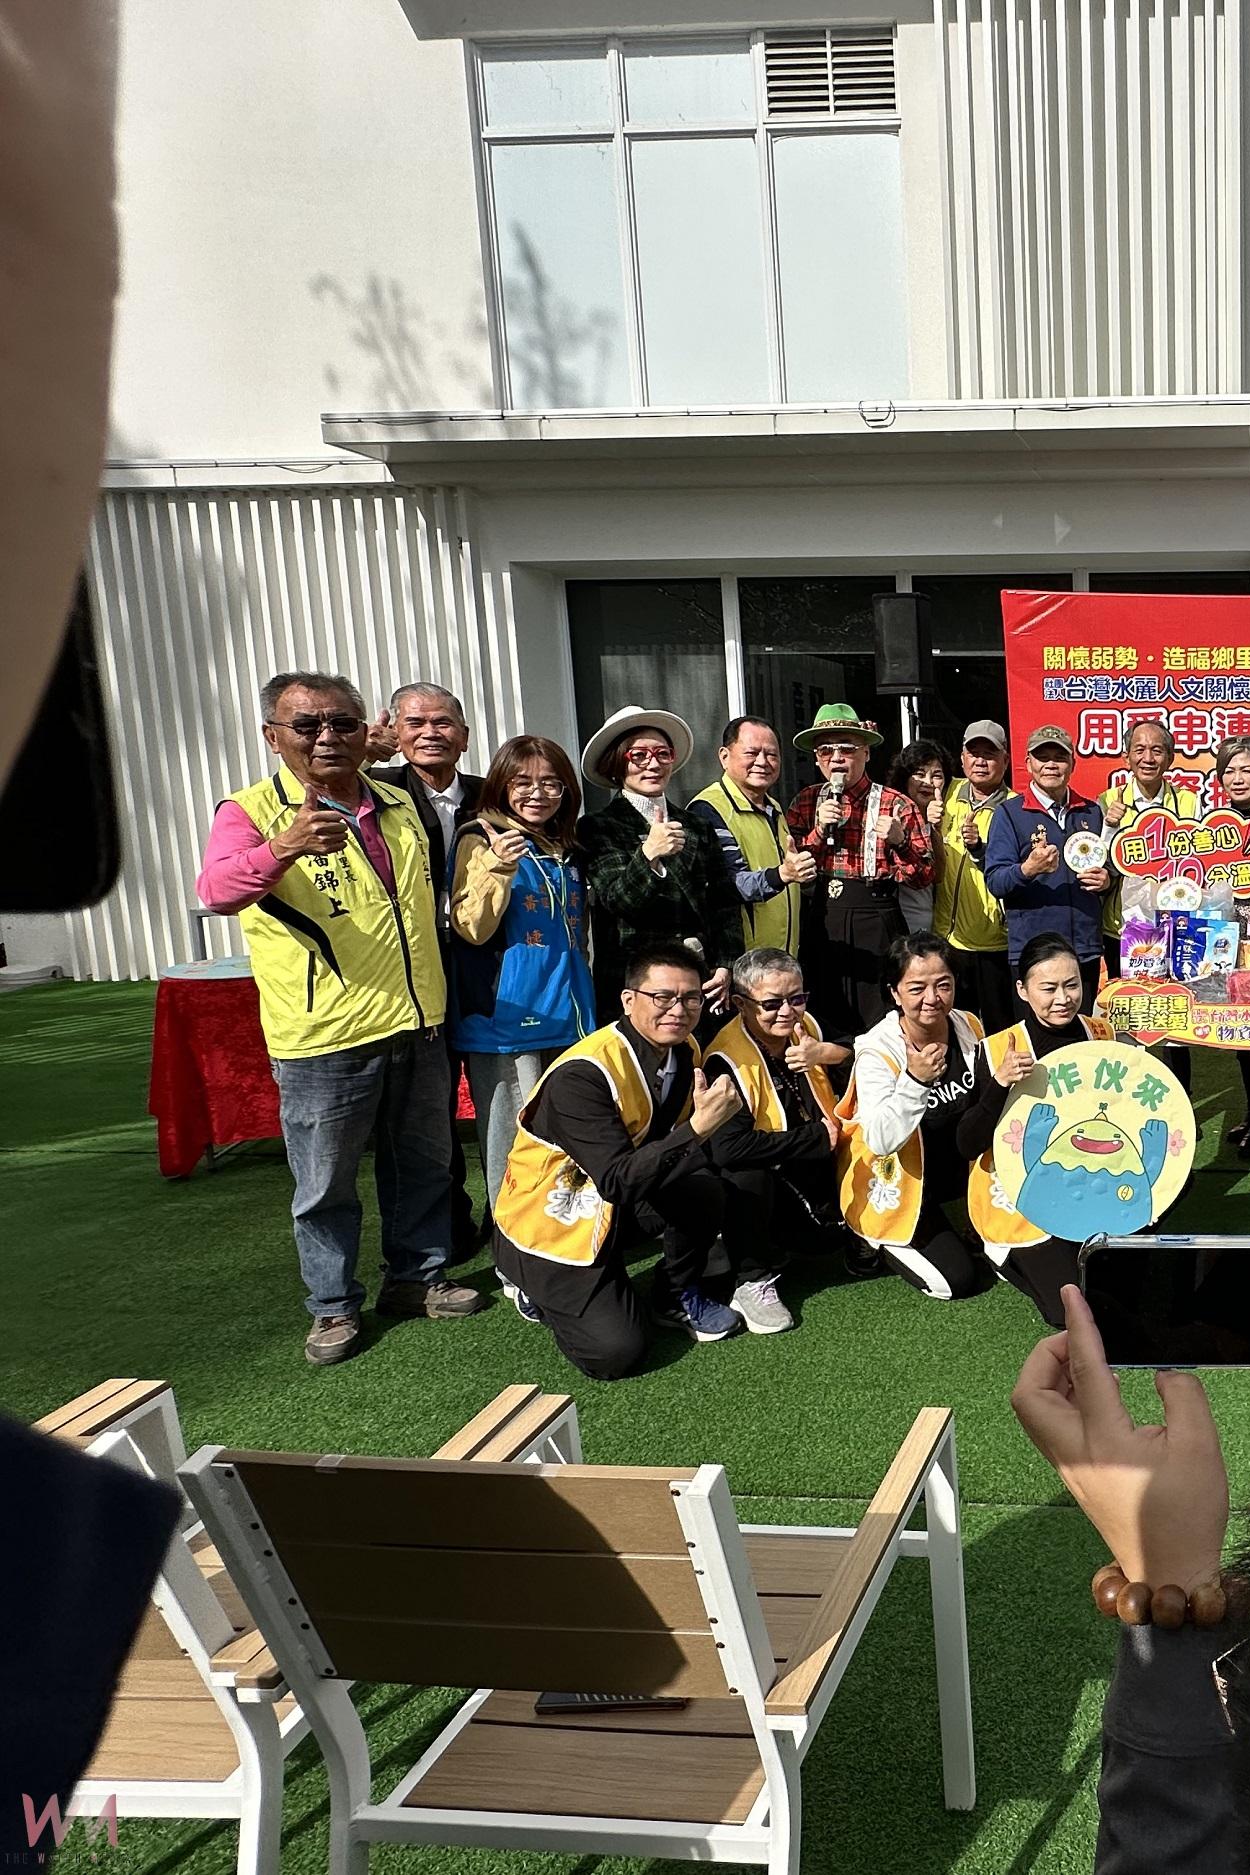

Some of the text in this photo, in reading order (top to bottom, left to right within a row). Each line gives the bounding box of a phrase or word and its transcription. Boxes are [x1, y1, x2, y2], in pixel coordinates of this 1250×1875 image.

[1122, 816, 1242, 865] 用1份善心
[337, 850, 358, 882] 里長
[1109, 994, 1189, 1014] 用愛串連
[927, 1070, 975, 1109] SWAG
